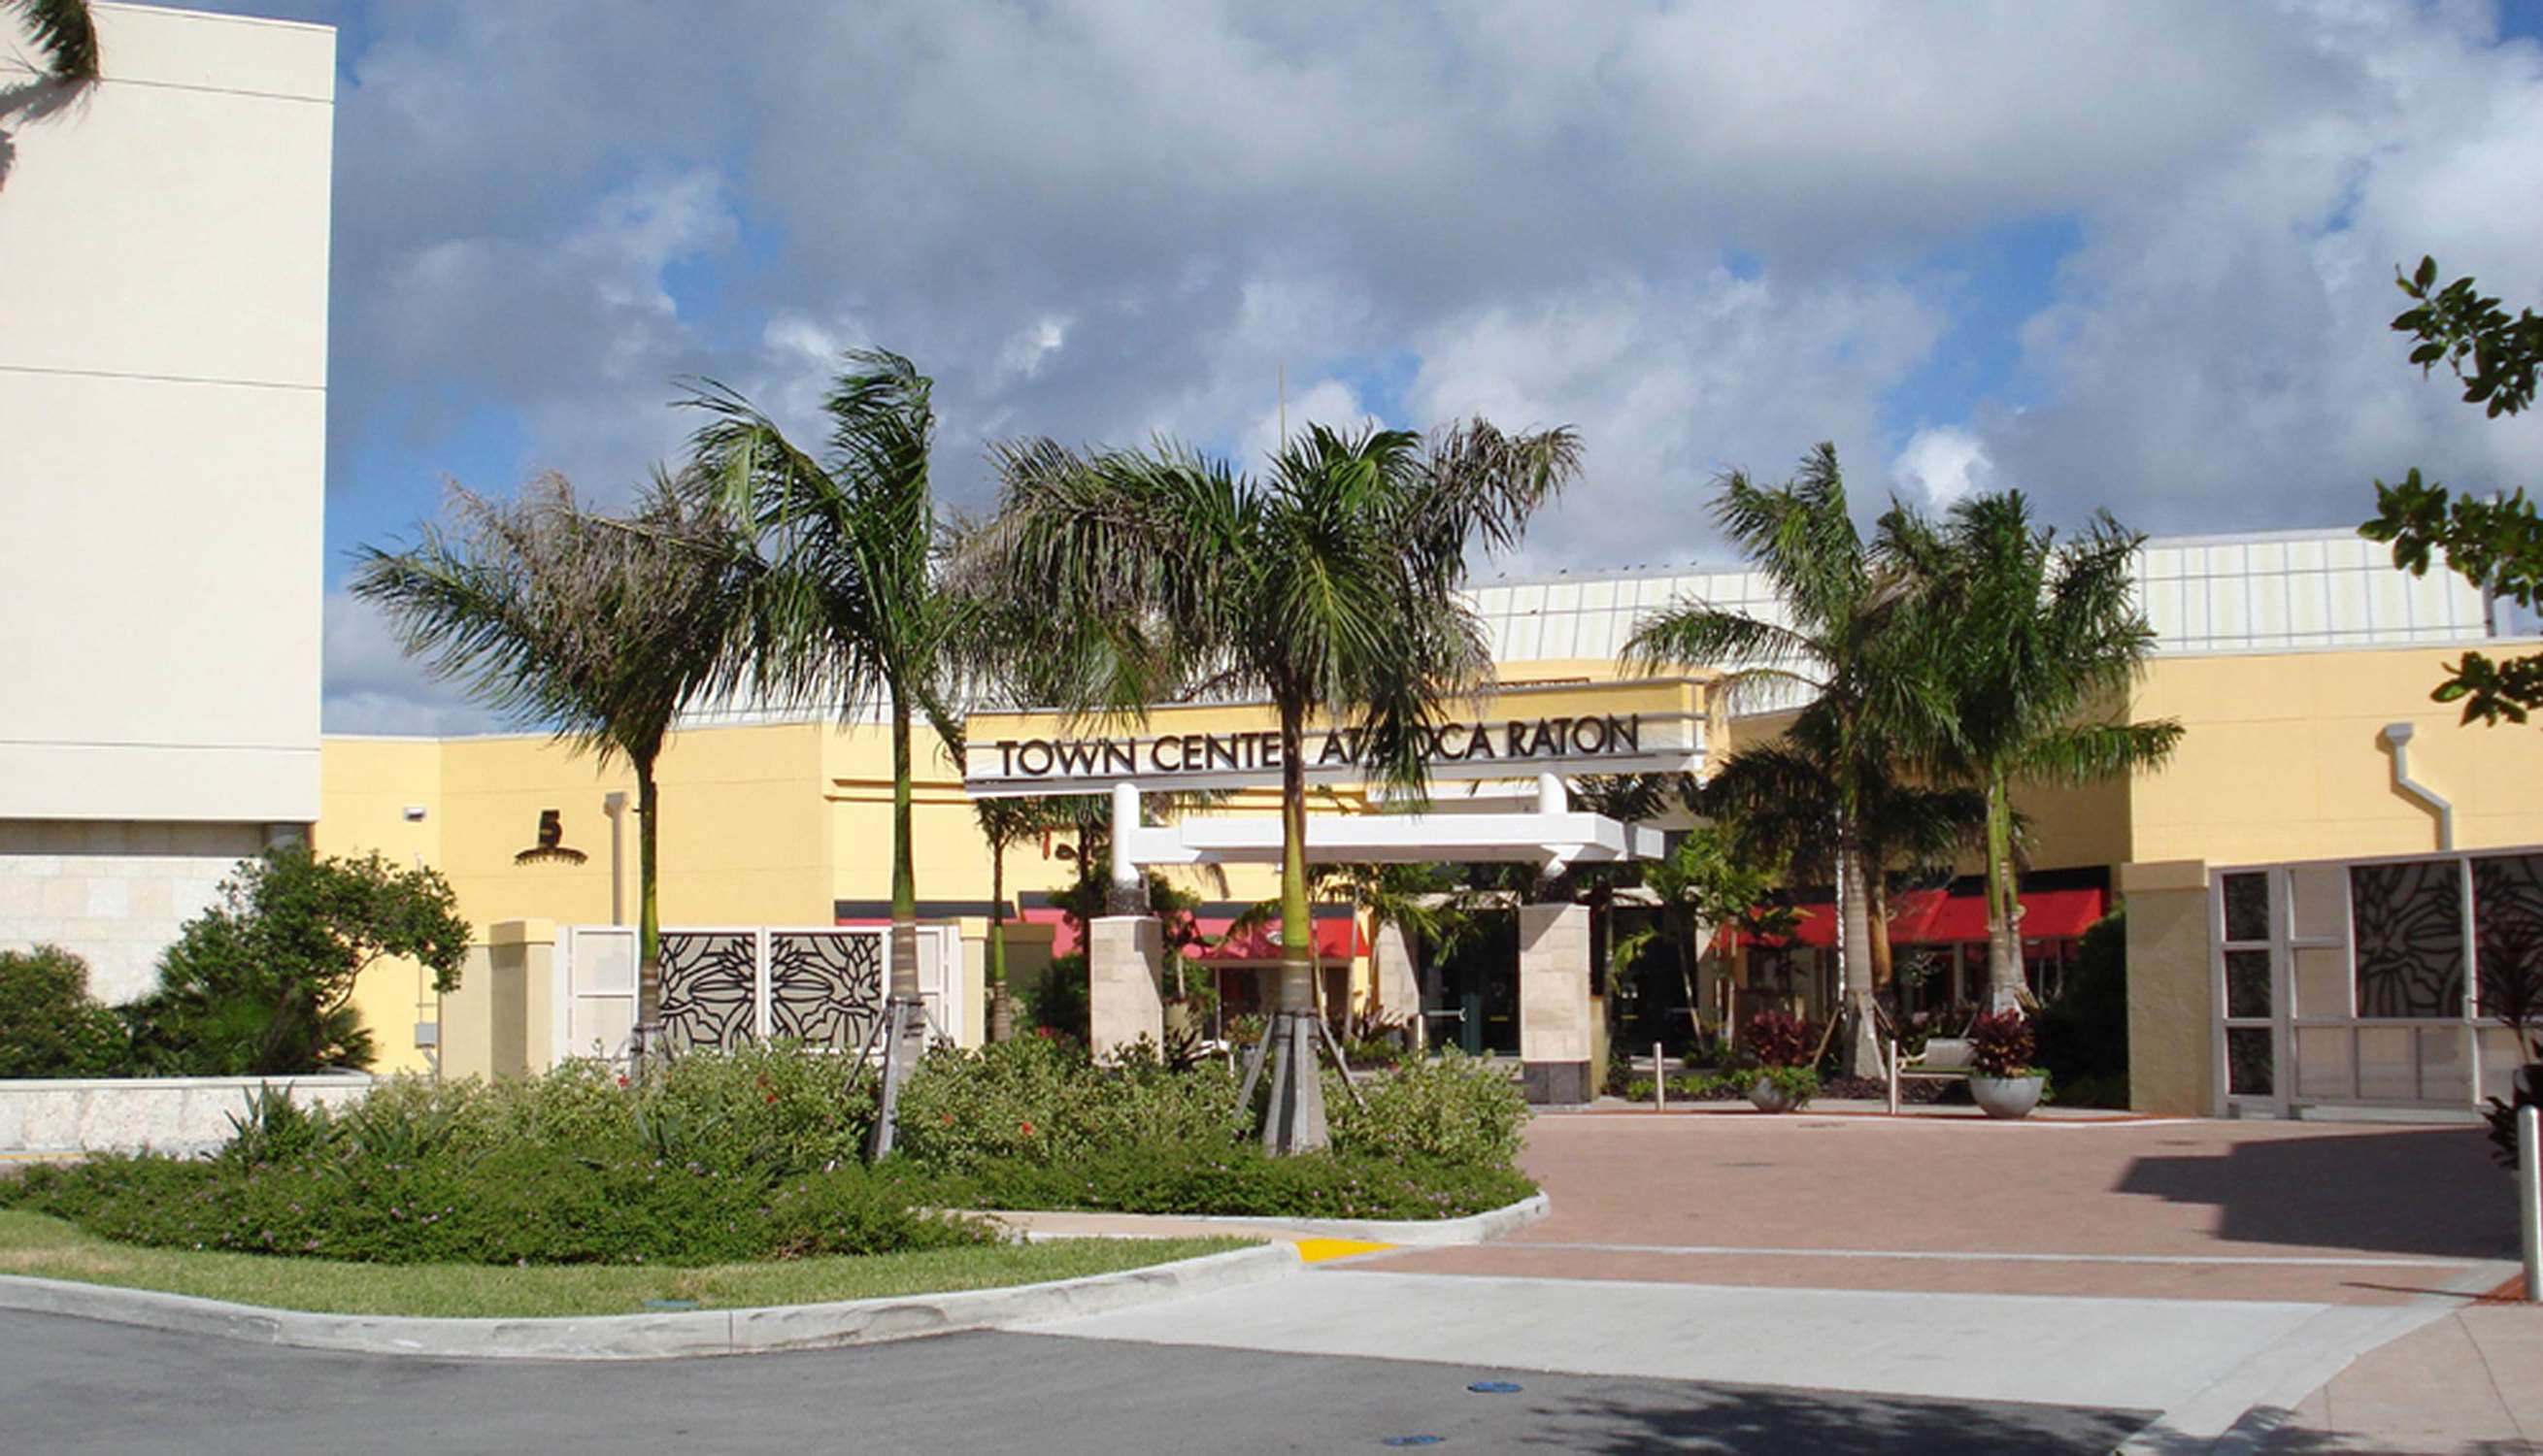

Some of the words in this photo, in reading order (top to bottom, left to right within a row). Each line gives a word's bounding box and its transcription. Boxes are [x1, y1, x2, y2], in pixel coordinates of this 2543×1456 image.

[996, 738, 1136, 777] TOWN
[1152, 732, 1283, 772] CENTE
[1508, 712, 1639, 757] RATON
